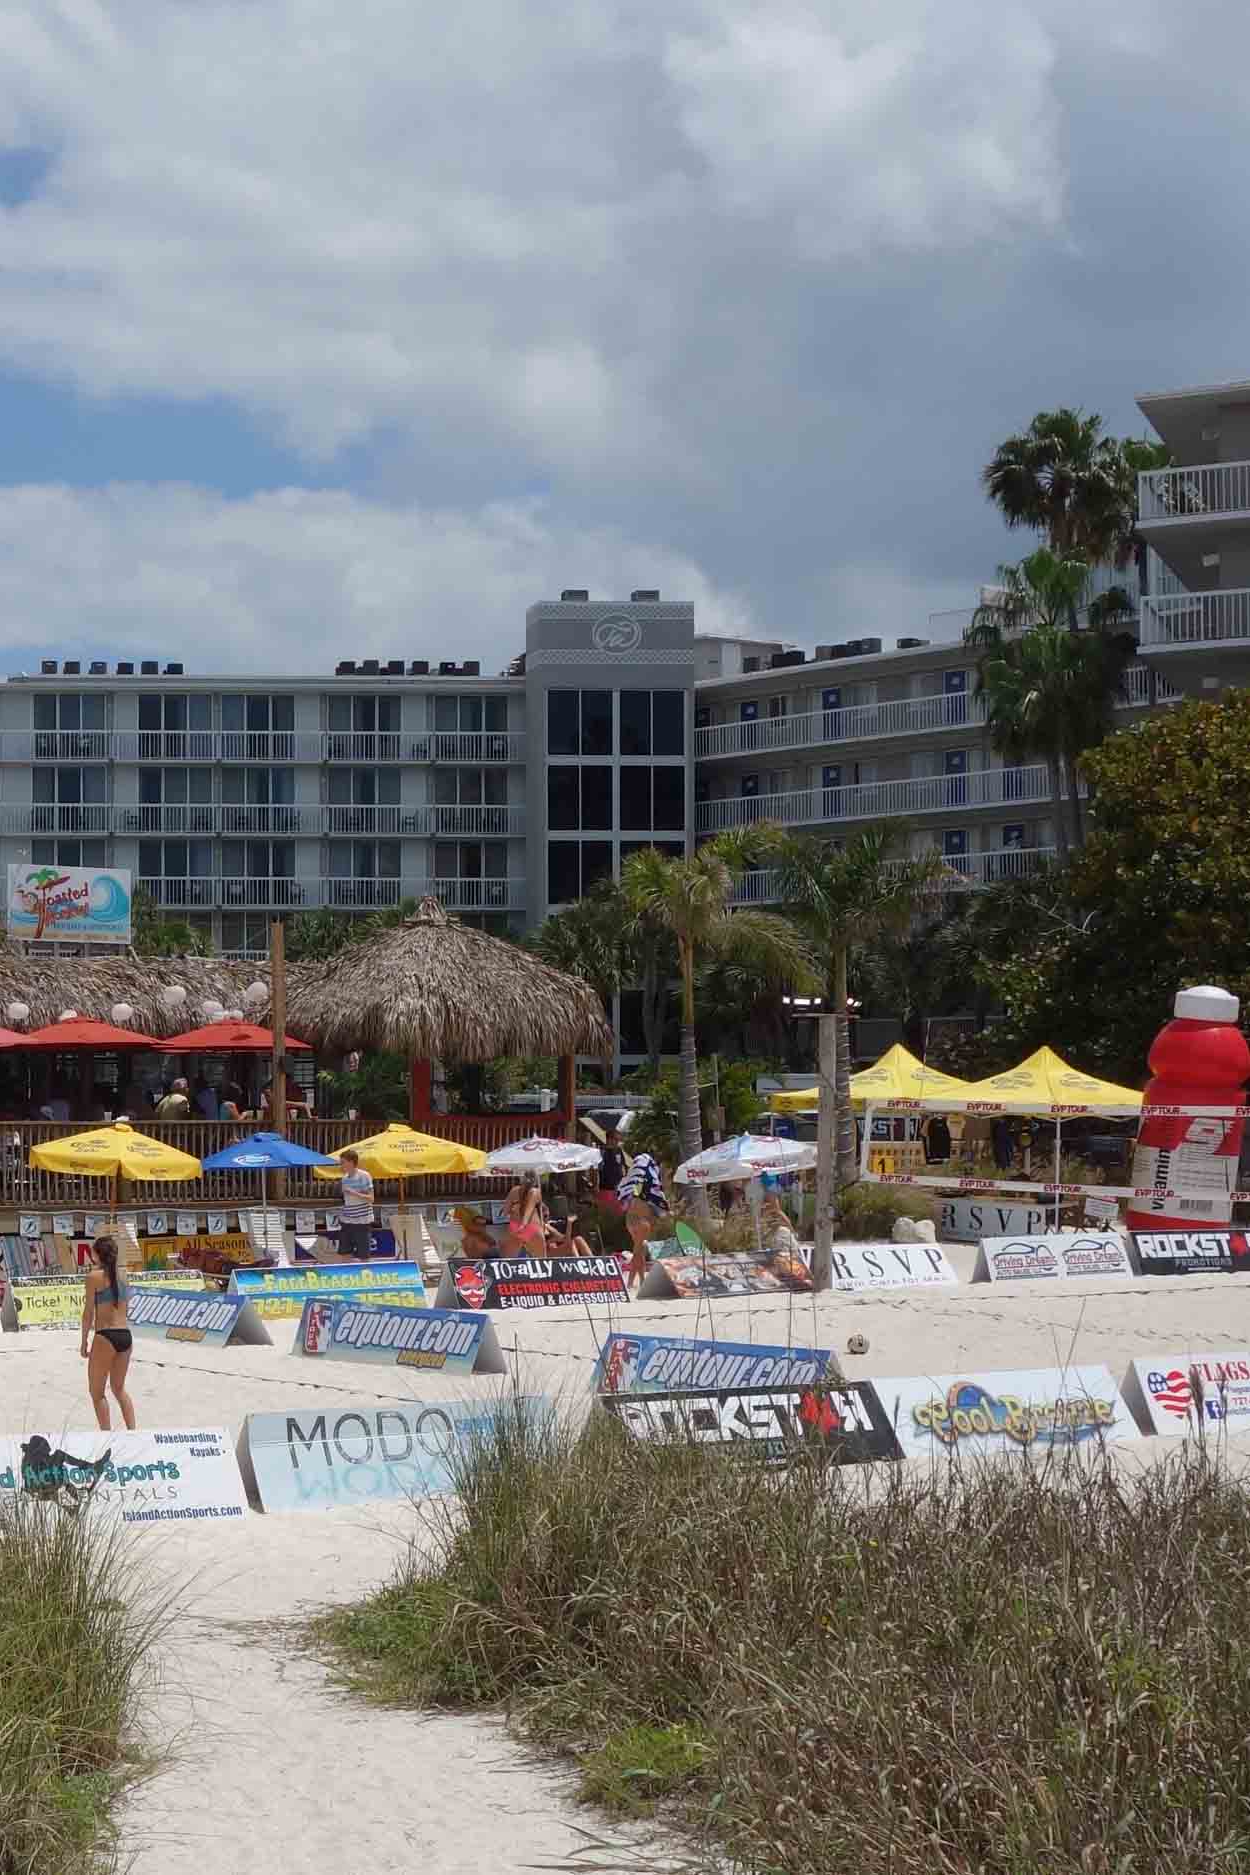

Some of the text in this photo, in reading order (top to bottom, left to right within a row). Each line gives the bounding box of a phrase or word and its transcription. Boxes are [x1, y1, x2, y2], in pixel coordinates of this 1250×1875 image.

[1151, 1148, 1171, 1210] viamin
[501, 1291, 627, 1308] E-LIQUID & ACCESSORIES
[335, 1310, 479, 1355] evptour.com
[641, 1346, 818, 1389] evptour.com
[154, 1432, 218, 1445] Wakeboarding
[286, 1407, 451, 1469] MODO
[189, 1447, 221, 1458] Kayaks
[101, 1460, 181, 1486] Sports
[123, 1506, 242, 1521] IslandActionSports.com
